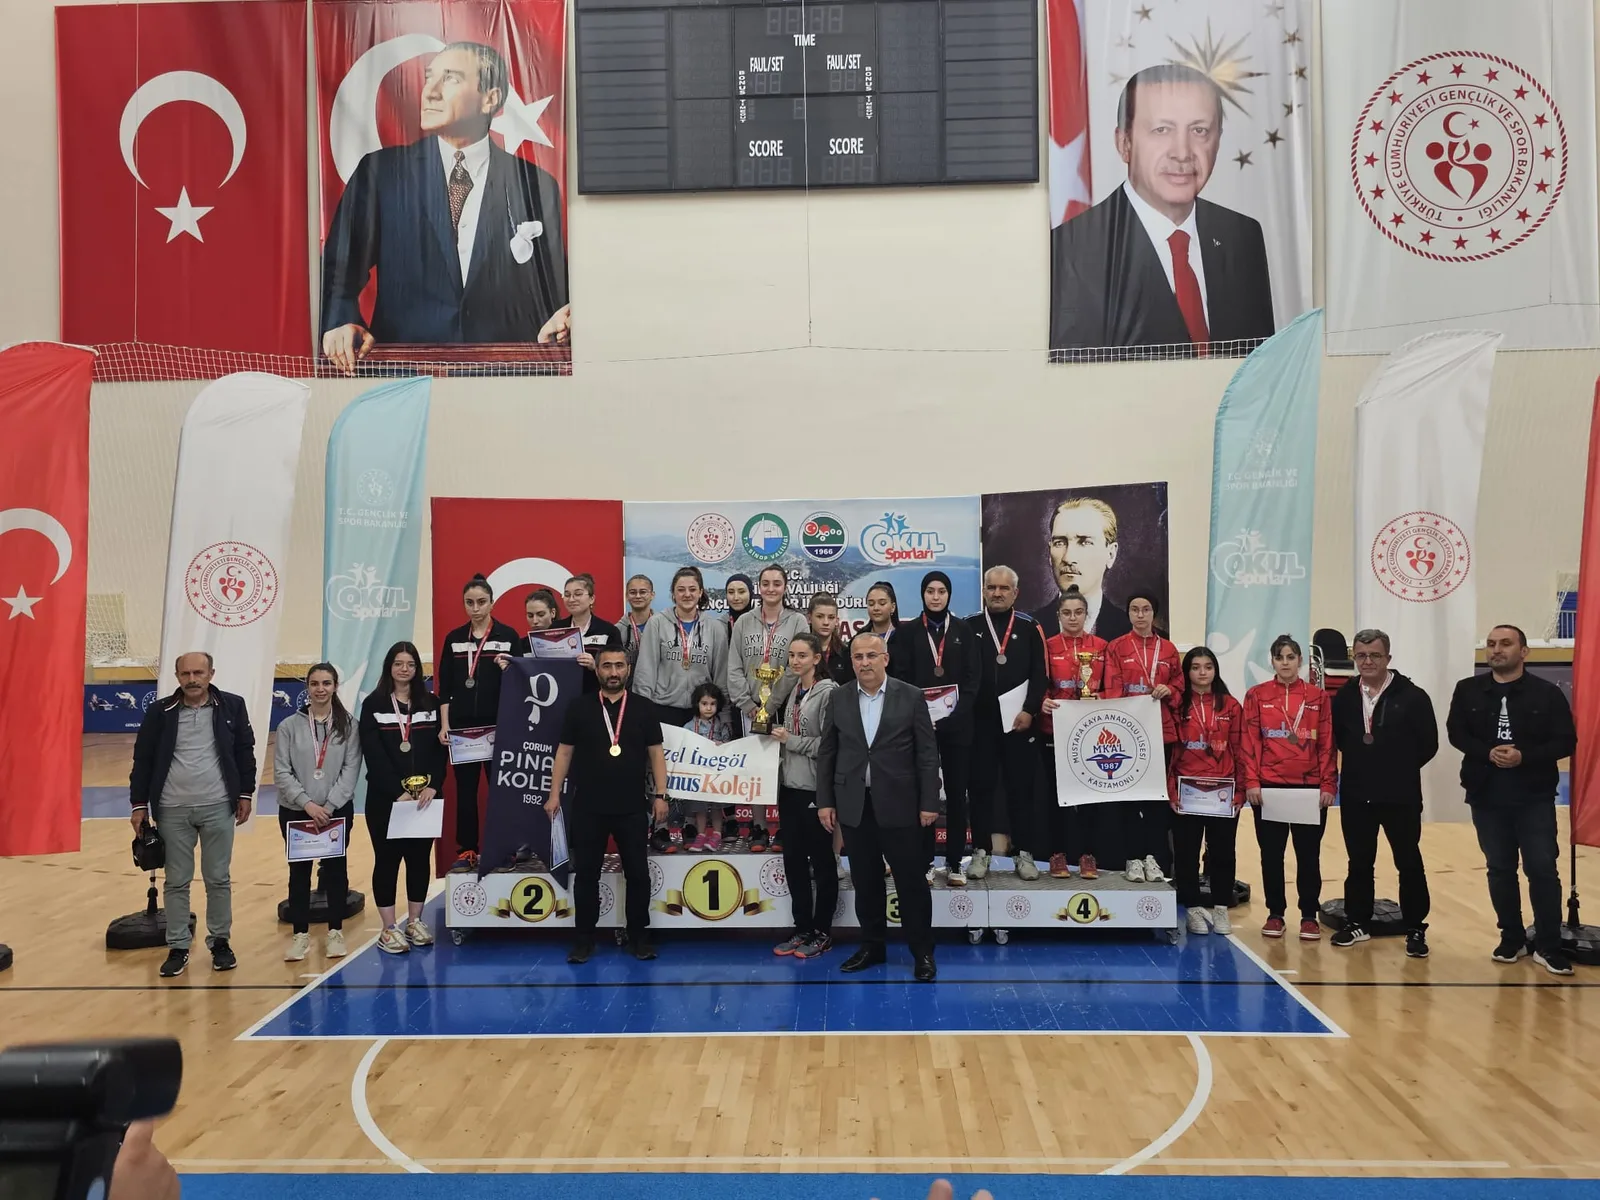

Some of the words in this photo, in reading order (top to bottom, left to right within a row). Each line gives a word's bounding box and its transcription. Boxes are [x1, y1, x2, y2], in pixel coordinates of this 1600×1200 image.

[793, 34, 816, 46] TIME
[749, 56, 784, 73] FAUL/SET
[826, 54, 862, 70] FAUL/SET
[738, 70, 746, 95] BONUS
[1438, 89, 1497, 108] GENÇLİK
[1497, 104, 1514, 121] VE
[1390, 93, 1436, 178] CUMHURİYETİ
[1509, 121, 1528, 155] SPOR
[749, 140, 784, 157] SCORE
[829, 138, 864, 155] SCORE
[1478, 159, 1528, 219] BAKANLIĞI
[1397, 180, 1443, 222] TÜRKİYE
[522, 741, 553, 753] ÇORUM
[1071, 728, 1084, 764] MUSTAFA
[1083, 715, 1103, 729] KAYA
[1104, 714, 1140, 735] ANADOLU
[500, 751, 554, 772] PINA
[662, 747, 685, 763] zel
[689, 746, 747, 771] İnegöl
[1100, 762, 1119, 770] 1987
[1087, 774, 1135, 789] KASTAMONU
[522, 794, 542, 805] 1992
[523, 884, 544, 915] 2
[702, 869, 720, 911] 1
[1076, 898, 1091, 919] 4
